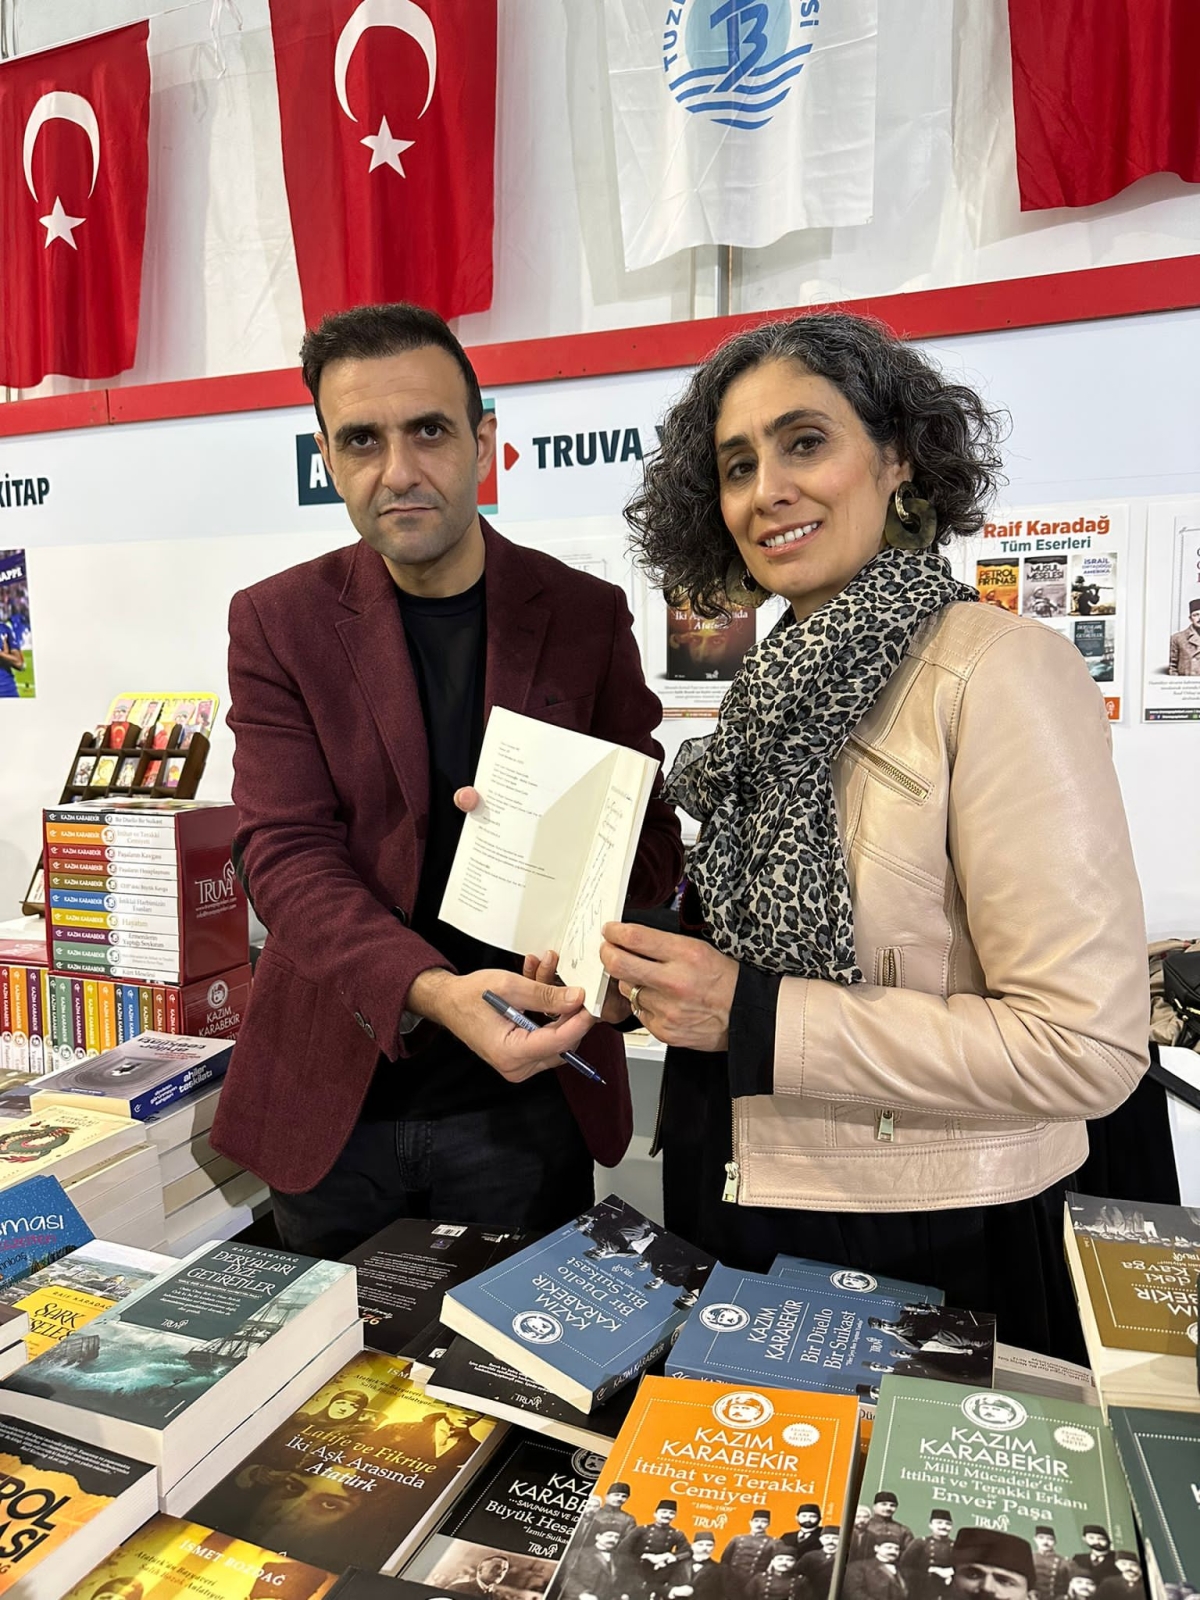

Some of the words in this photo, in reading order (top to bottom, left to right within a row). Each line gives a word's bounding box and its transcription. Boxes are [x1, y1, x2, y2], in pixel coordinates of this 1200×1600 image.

[663, 0, 687, 72] TUZ
[532, 427, 643, 470] TRUVA
[983, 521, 1022, 538] Raif
[1027, 515, 1110, 536] Karadağ
[1000, 539, 1031, 553] Tüm
[1036, 536, 1091, 551] Eserleri
[979, 569, 1016, 578] PETROL
[1030, 564, 1060, 573] MUSUL
[194, 862, 235, 904] TRUVA
[199, 1010, 240, 1037] KARABEKİR
[207, 1006, 232, 1024] KAZIM
[183, 1064, 207, 1082] ahiler
[0, 1214, 64, 1236] ması
[211, 1251, 297, 1276] DERYALARI
[222, 1263, 261, 1280] DİZE
[564, 1256, 621, 1294] Suikast
[1121, 1260, 1189, 1276] Kavga
[186, 1267, 277, 1296] GETİRENLER
[557, 1265, 609, 1304] Düello
[1133, 1287, 1198, 1304] BEKİR
[531, 1273, 622, 1332] KARABEKİR
[534, 1293, 591, 1331] KAZIM
[609, 1298, 636, 1317] Bir
[621, 1290, 649, 1310] Bir
[747, 1307, 778, 1343] KAZIM
[764, 1299, 804, 1360] KARABEKİR
[806, 1308, 834, 1345] Düello
[829, 1310, 856, 1351] Suikast
[800, 1345, 821, 1364] Bir
[823, 1353, 845, 1370] Bir
[387, 1367, 410, 1379] İSM
[301, 1424, 353, 1447] Latife
[353, 1439, 375, 1453] ve
[377, 1445, 438, 1475] Fikriye
[694, 1427, 774, 1451] KAZIM
[950, 1426, 1037, 1455] KAZIM
[285, 1434, 310, 1453] İki
[311, 1446, 347, 1466] Aşk
[348, 1456, 426, 1490] Arasında
[660, 1440, 799, 1472] KARABEKİR
[919, 1438, 1069, 1478] KARABEKİR
[305, 1461, 379, 1493] Atatürk
[547, 1473, 594, 1497] KAZ
[632, 1458, 698, 1481] İttihat
[702, 1473, 727, 1485] ve
[733, 1473, 815, 1495] Terakki
[900, 1467, 946, 1485] İttihat
[950, 1478, 968, 1488] ve
[971, 1480, 1031, 1500] Terakki
[1035, 1491, 1088, 1511] Erkanı
[924, 1461, 959, 1475] Milli
[964, 1467, 1064, 1493] Mücadele'de
[0, 1473, 72, 1530] ROL
[508, 1479, 589, 1514] KARABE
[670, 1480, 768, 1506] Cemiyeti
[932, 1486, 997, 1510] Enver
[1003, 1499, 1054, 1521] Paşa
[485, 1500, 535, 1524] Büyük
[536, 1516, 575, 1535] Hesa
[561, 1512, 571, 1520] VE
[692, 1512, 728, 1530] TRUVA
[971, 1513, 1011, 1532] TRUVA
[528, 1541, 558, 1558] TRUVA
[546, 1533, 569, 1544] Suikas
[225, 1557, 286, 1586] BOZDAĞ
